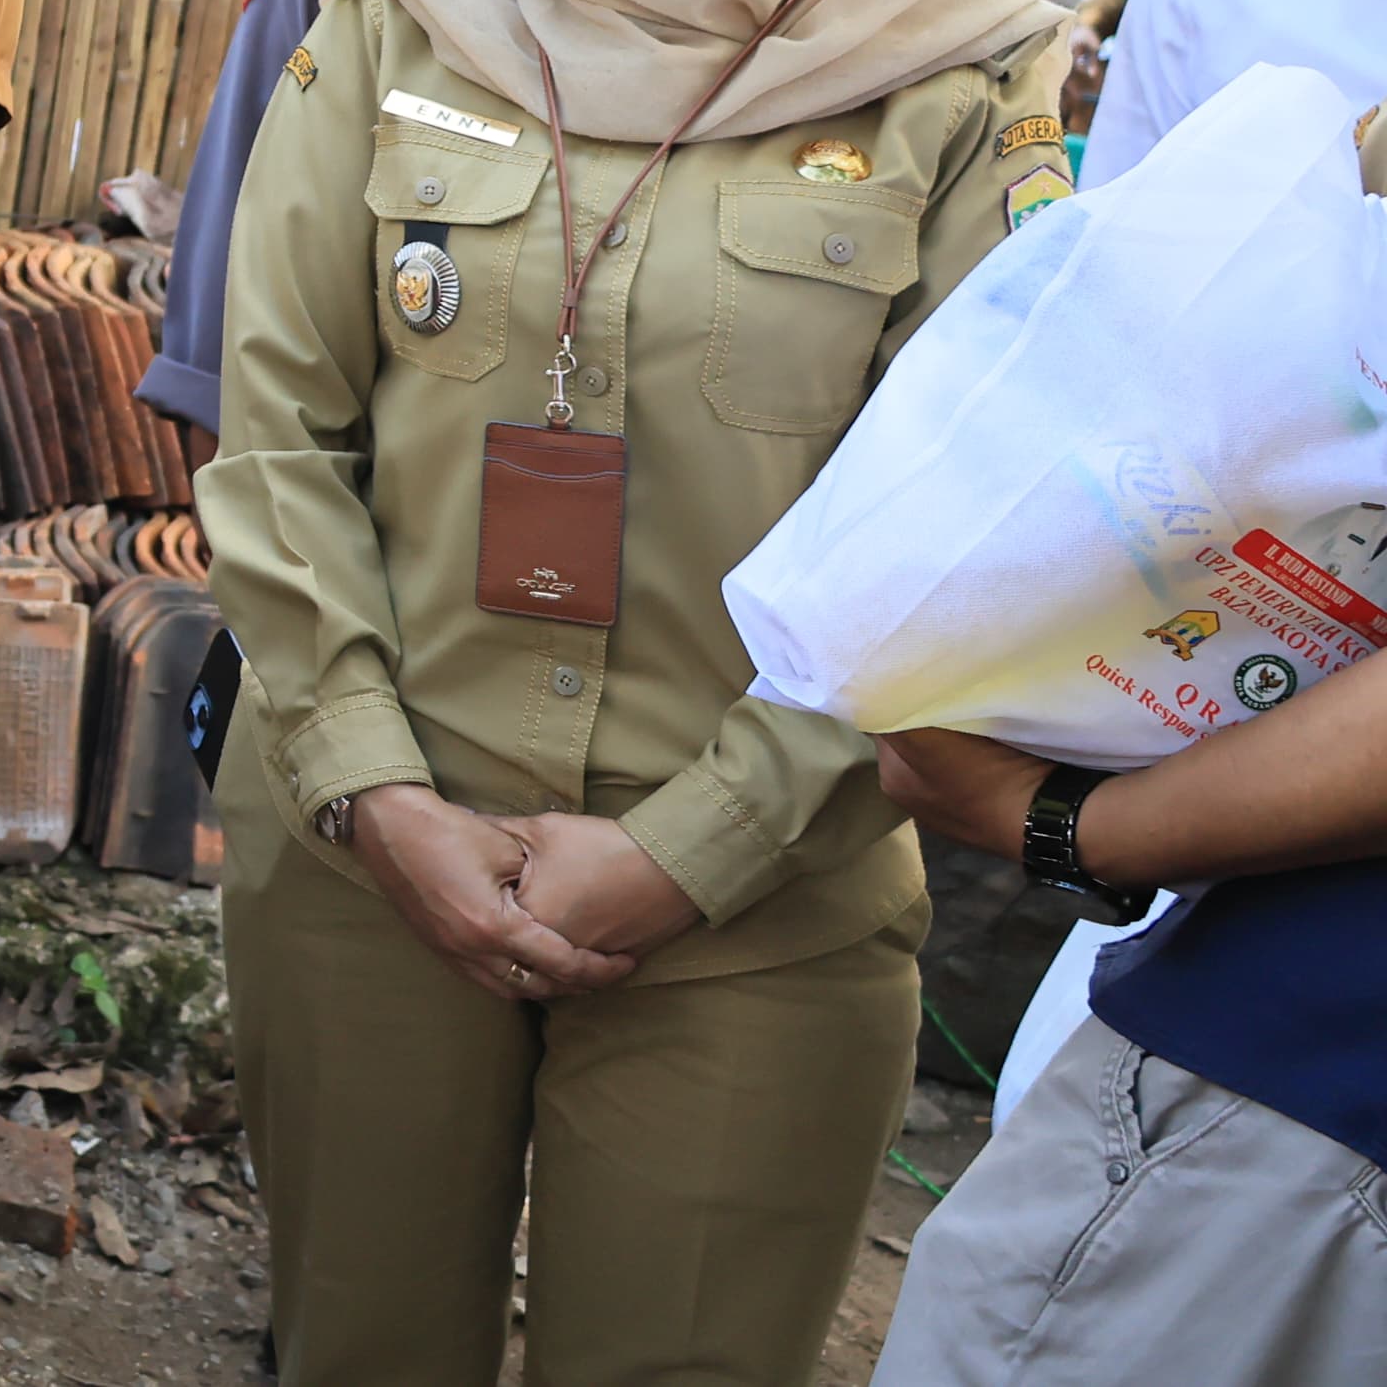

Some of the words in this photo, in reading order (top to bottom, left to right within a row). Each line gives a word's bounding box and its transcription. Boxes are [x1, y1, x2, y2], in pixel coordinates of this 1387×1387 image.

[416, 103, 489, 133] ENNI
[1194, 546, 1234, 577] UPZ
[1229, 569, 1347, 642] PEMERINTAH
[1279, 550, 1310, 580] BUDI
[1302, 565, 1354, 609] RUSTANDI
[1208, 586, 1274, 629] BAZNAS
[1272, 621, 1330, 670] KOTA
[1085, 654, 1138, 696] Quick
[1137, 688, 1197, 739] Respon
[1174, 682, 1200, 711] Q
[1198, 699, 1223, 725] R
